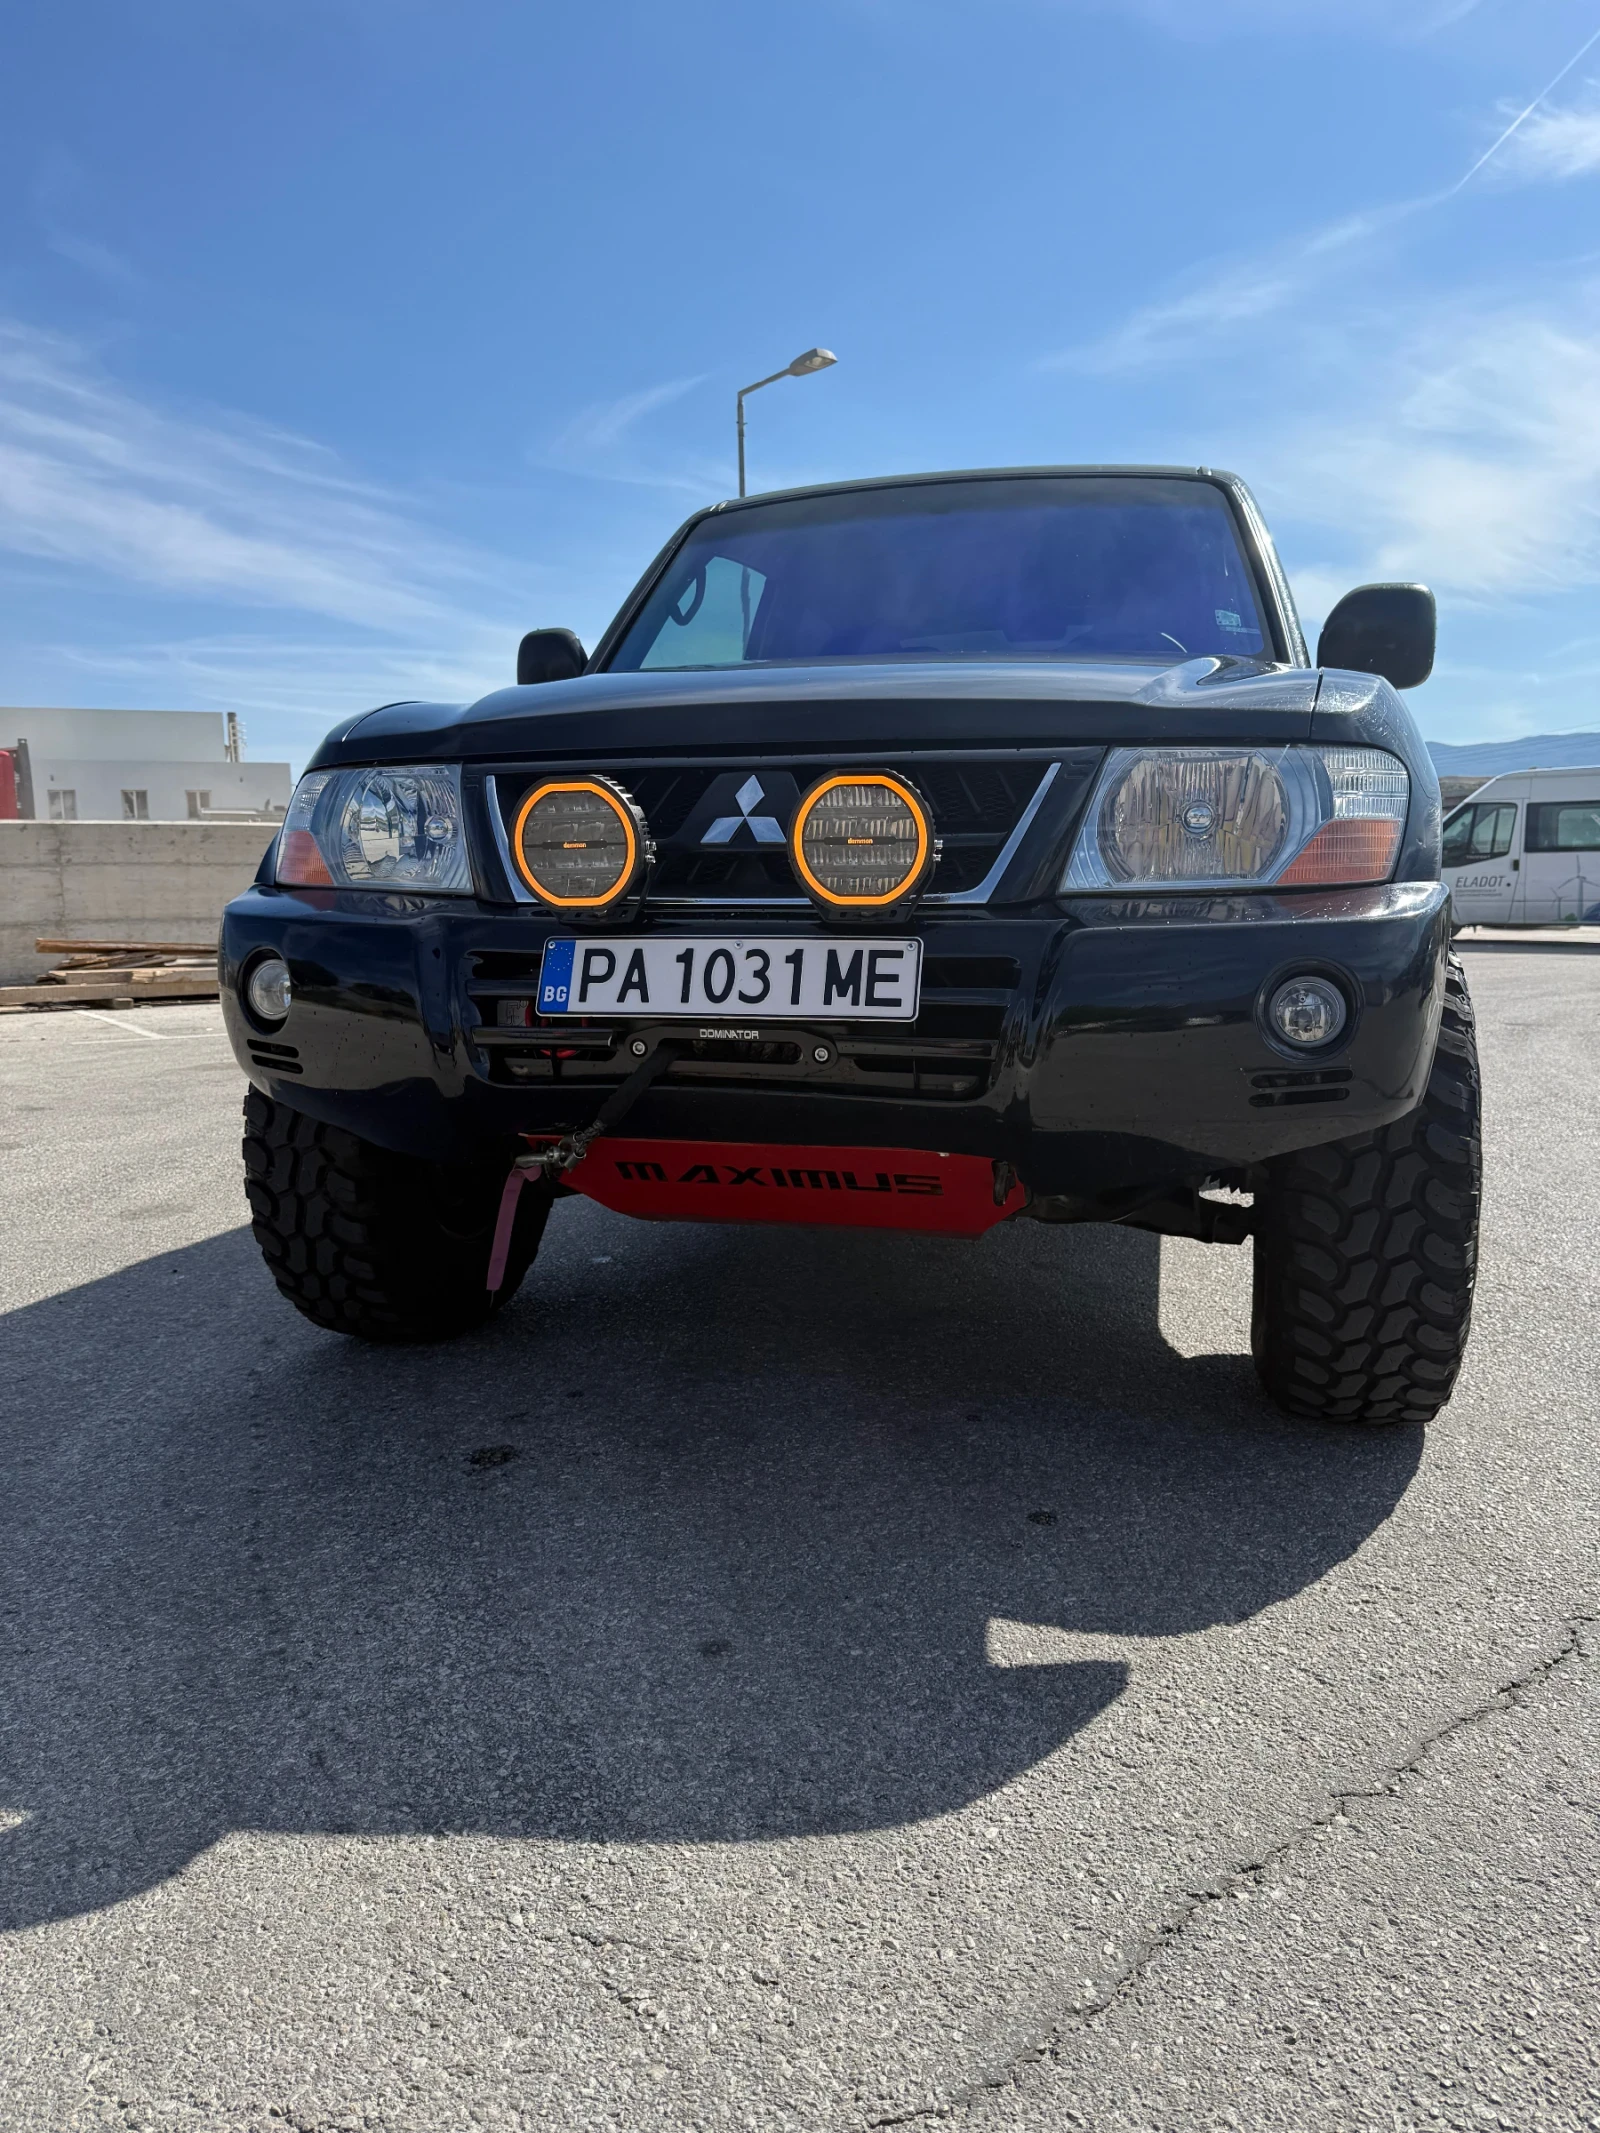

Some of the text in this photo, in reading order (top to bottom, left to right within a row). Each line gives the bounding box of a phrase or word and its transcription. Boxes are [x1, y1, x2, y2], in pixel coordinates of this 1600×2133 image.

[1455, 875, 1507, 888] ELADOT
[578, 948, 904, 1007] PA 1031 ME
[543, 985, 568, 1003] BG
[699, 1028, 760, 1040] DOMINATOR
[614, 1161, 944, 1196] MAXIMUS
